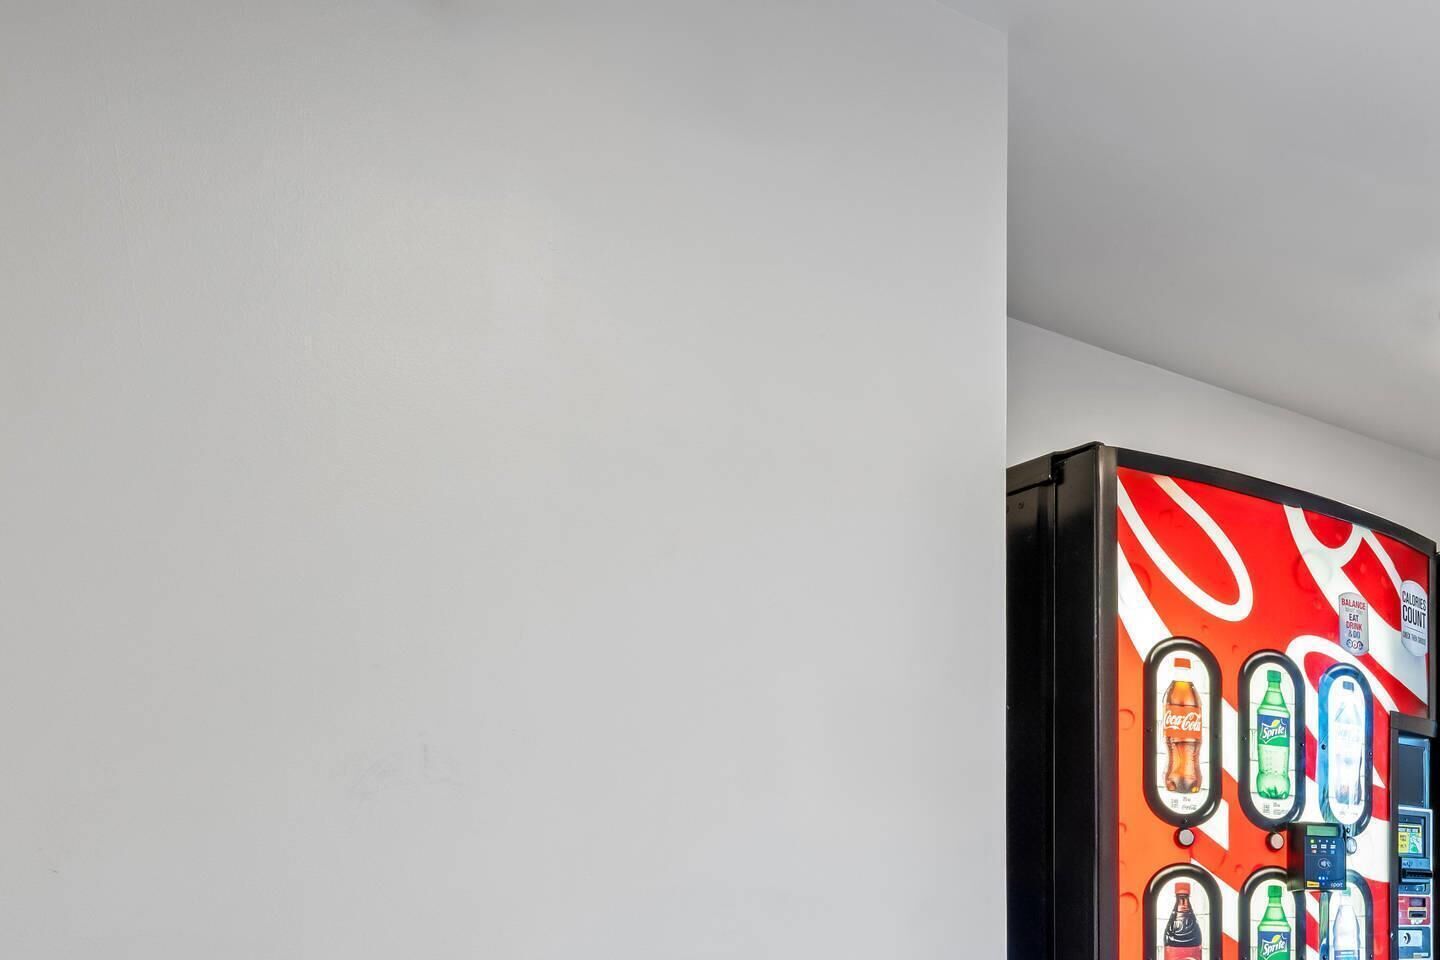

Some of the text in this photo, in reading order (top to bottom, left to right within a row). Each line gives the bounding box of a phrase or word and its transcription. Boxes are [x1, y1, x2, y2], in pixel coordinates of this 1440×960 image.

[1341, 597, 1366, 610] BALANCE
[1401, 590, 1427, 612] CALORIES
[1348, 613, 1359, 622] EAT
[1402, 604, 1427, 629] COUNT
[1345, 621, 1362, 631] DRINK
[1262, 724, 1285, 739] Sprite
[1263, 941, 1286, 956] Sprite
